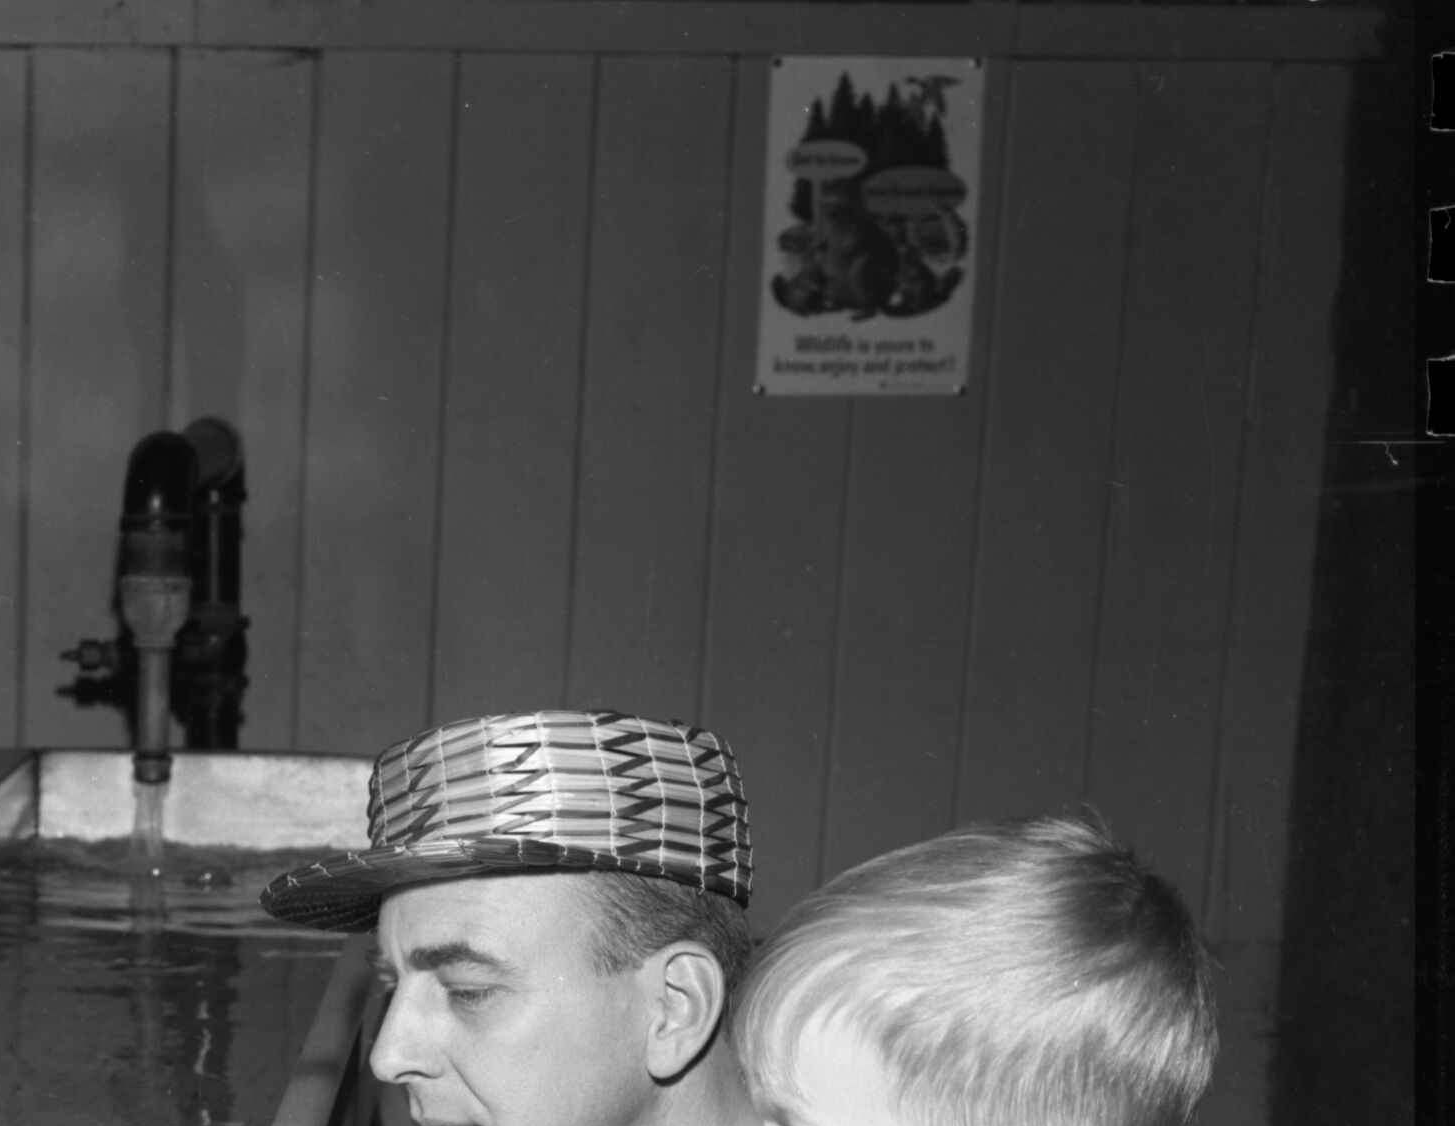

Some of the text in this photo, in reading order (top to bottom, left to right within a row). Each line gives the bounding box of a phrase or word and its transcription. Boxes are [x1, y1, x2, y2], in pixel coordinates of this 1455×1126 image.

[795, 333, 934, 356] Wildlife is yours to
[863, 356, 891, 373] and
